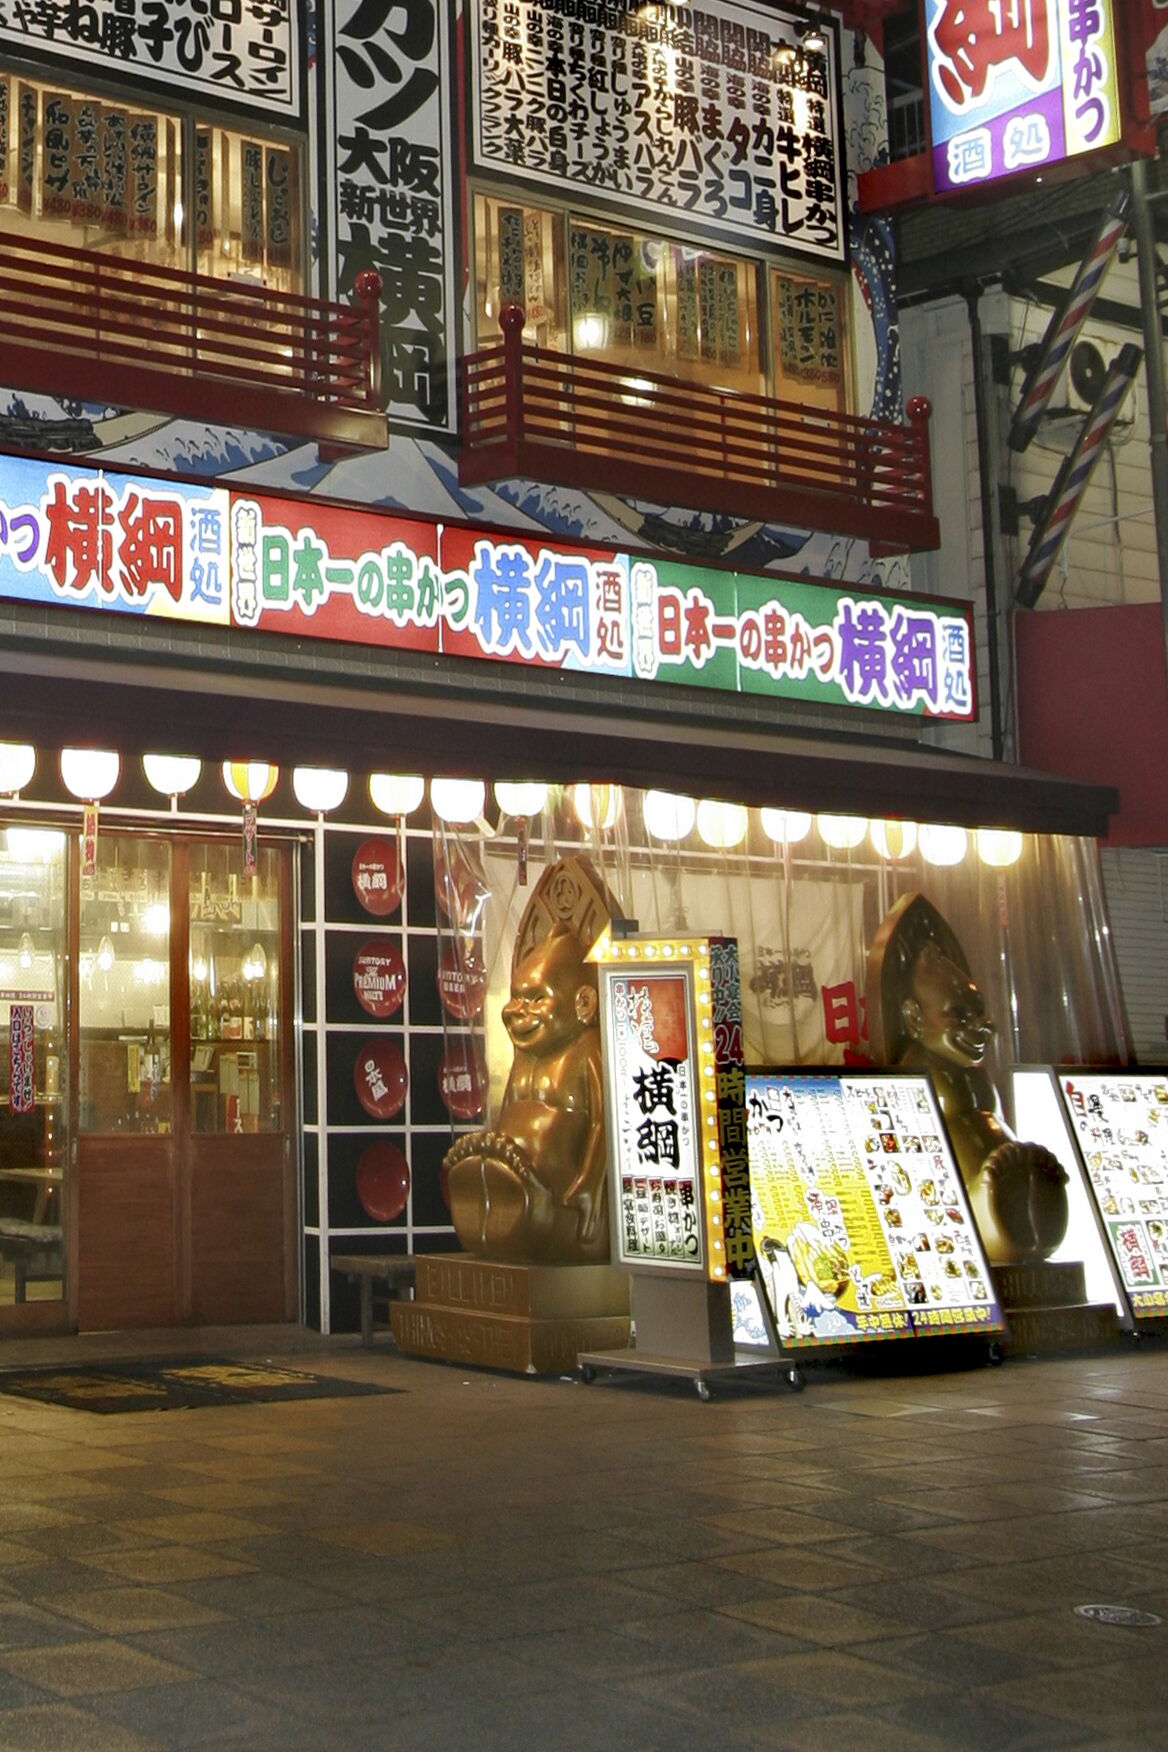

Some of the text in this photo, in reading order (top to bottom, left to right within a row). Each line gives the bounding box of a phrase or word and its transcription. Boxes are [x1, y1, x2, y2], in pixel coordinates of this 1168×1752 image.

[338, 126, 440, 198] 大阪
[546, 49, 569, 175] 本日の白身
[567, 59, 589, 181] ちくわチーズ
[588, 65, 612, 187] 紅しょうが
[673, 92, 703, 212] 豚バラ
[701, 100, 729, 218] まぐろ
[726, 113, 752, 211] タコ
[950, 122, 1049, 176] 酒処
[339, 178, 441, 238] 新世界
[751, 115, 779, 232] カニ身
[776, 122, 804, 238] 牛ヒレ
[45, 482, 183, 602] 横綱
[190, 507, 222, 605] 酒処
[262, 534, 469, 623] 日本一の串かつ
[474, 546, 590, 658] 横綱
[596, 569, 623, 660] 酒処
[657, 594, 835, 675] 日本一の串かつ
[838, 605, 939, 704] 横綱
[942, 623, 968, 707] 酒処
[632, 1066, 681, 1170] 横綱
[714, 1027, 754, 1270] 24 時間営業中
